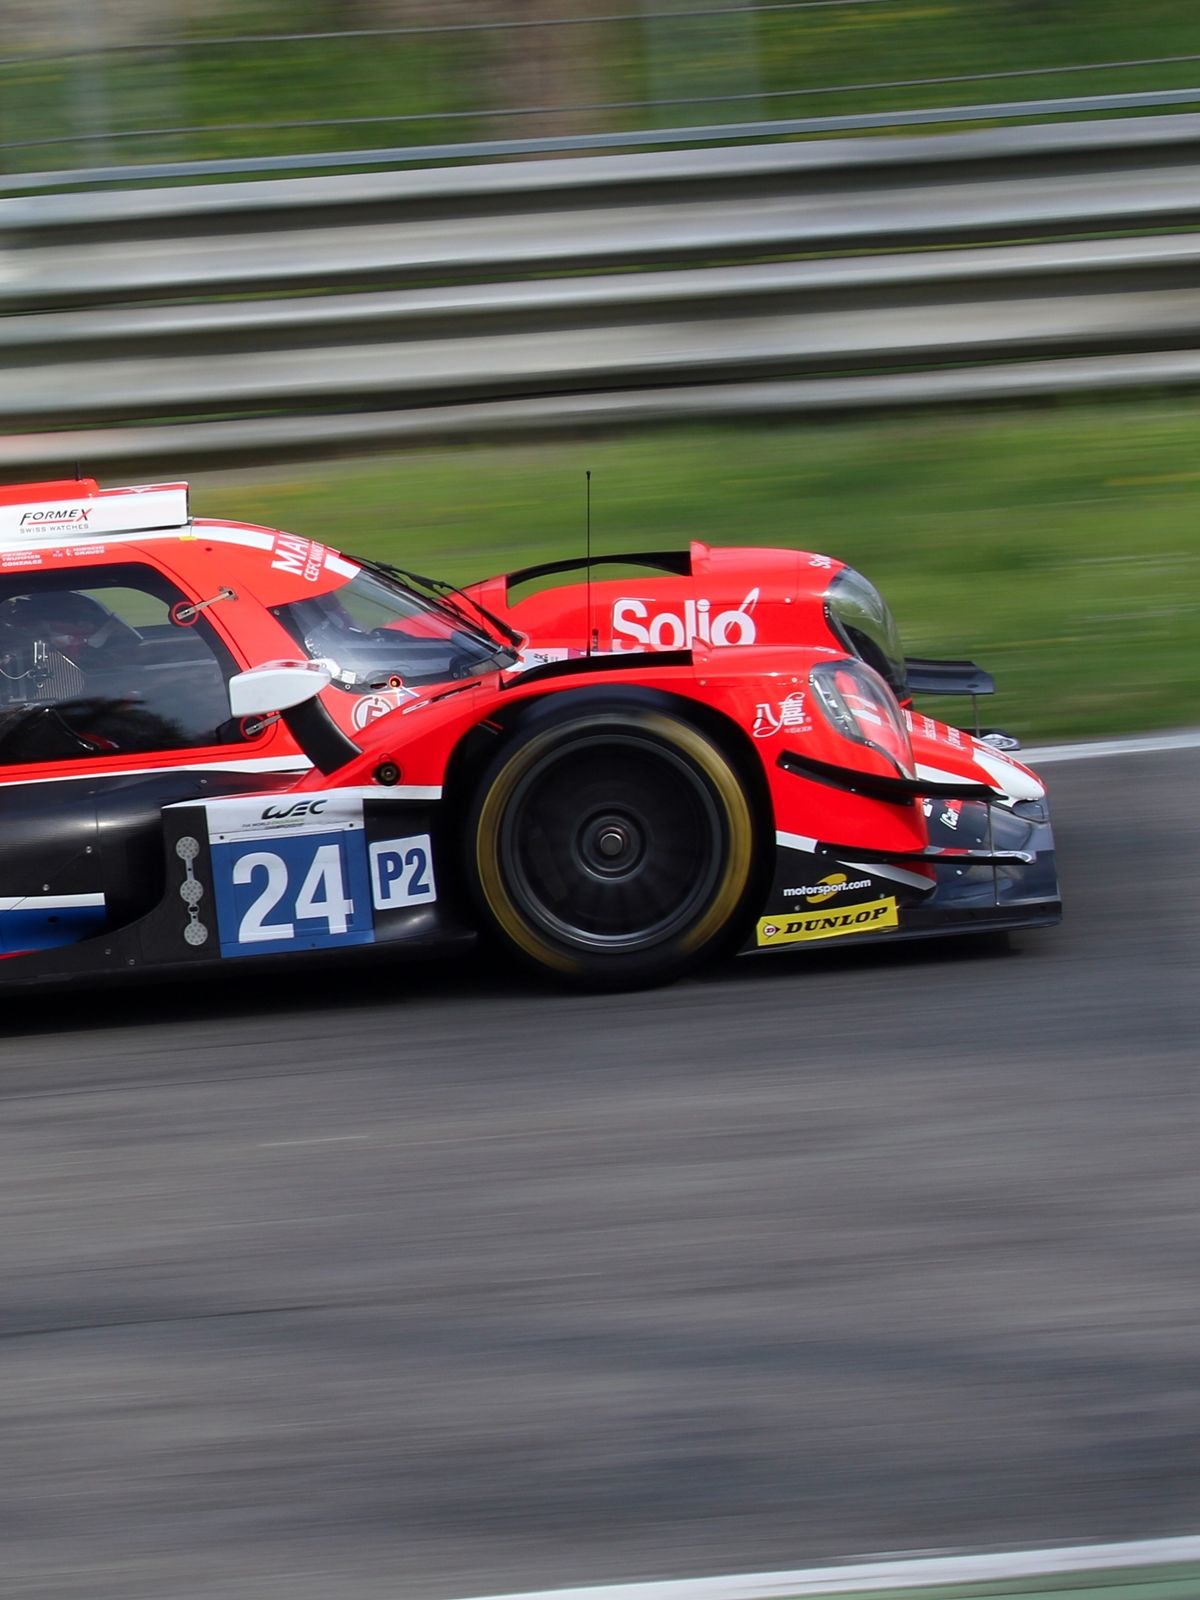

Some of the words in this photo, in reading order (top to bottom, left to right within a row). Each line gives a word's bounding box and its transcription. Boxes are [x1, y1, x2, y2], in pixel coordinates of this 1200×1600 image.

[20, 526, 47, 534] SWISS
[50, 523, 89, 531] WATCHES
[261, 799, 328, 820] WEC
[377, 846, 431, 900] P2
[232, 844, 354, 944] 24
[783, 878, 872, 897] motorsport.com
[784, 906, 888, 934] DUNLOP
